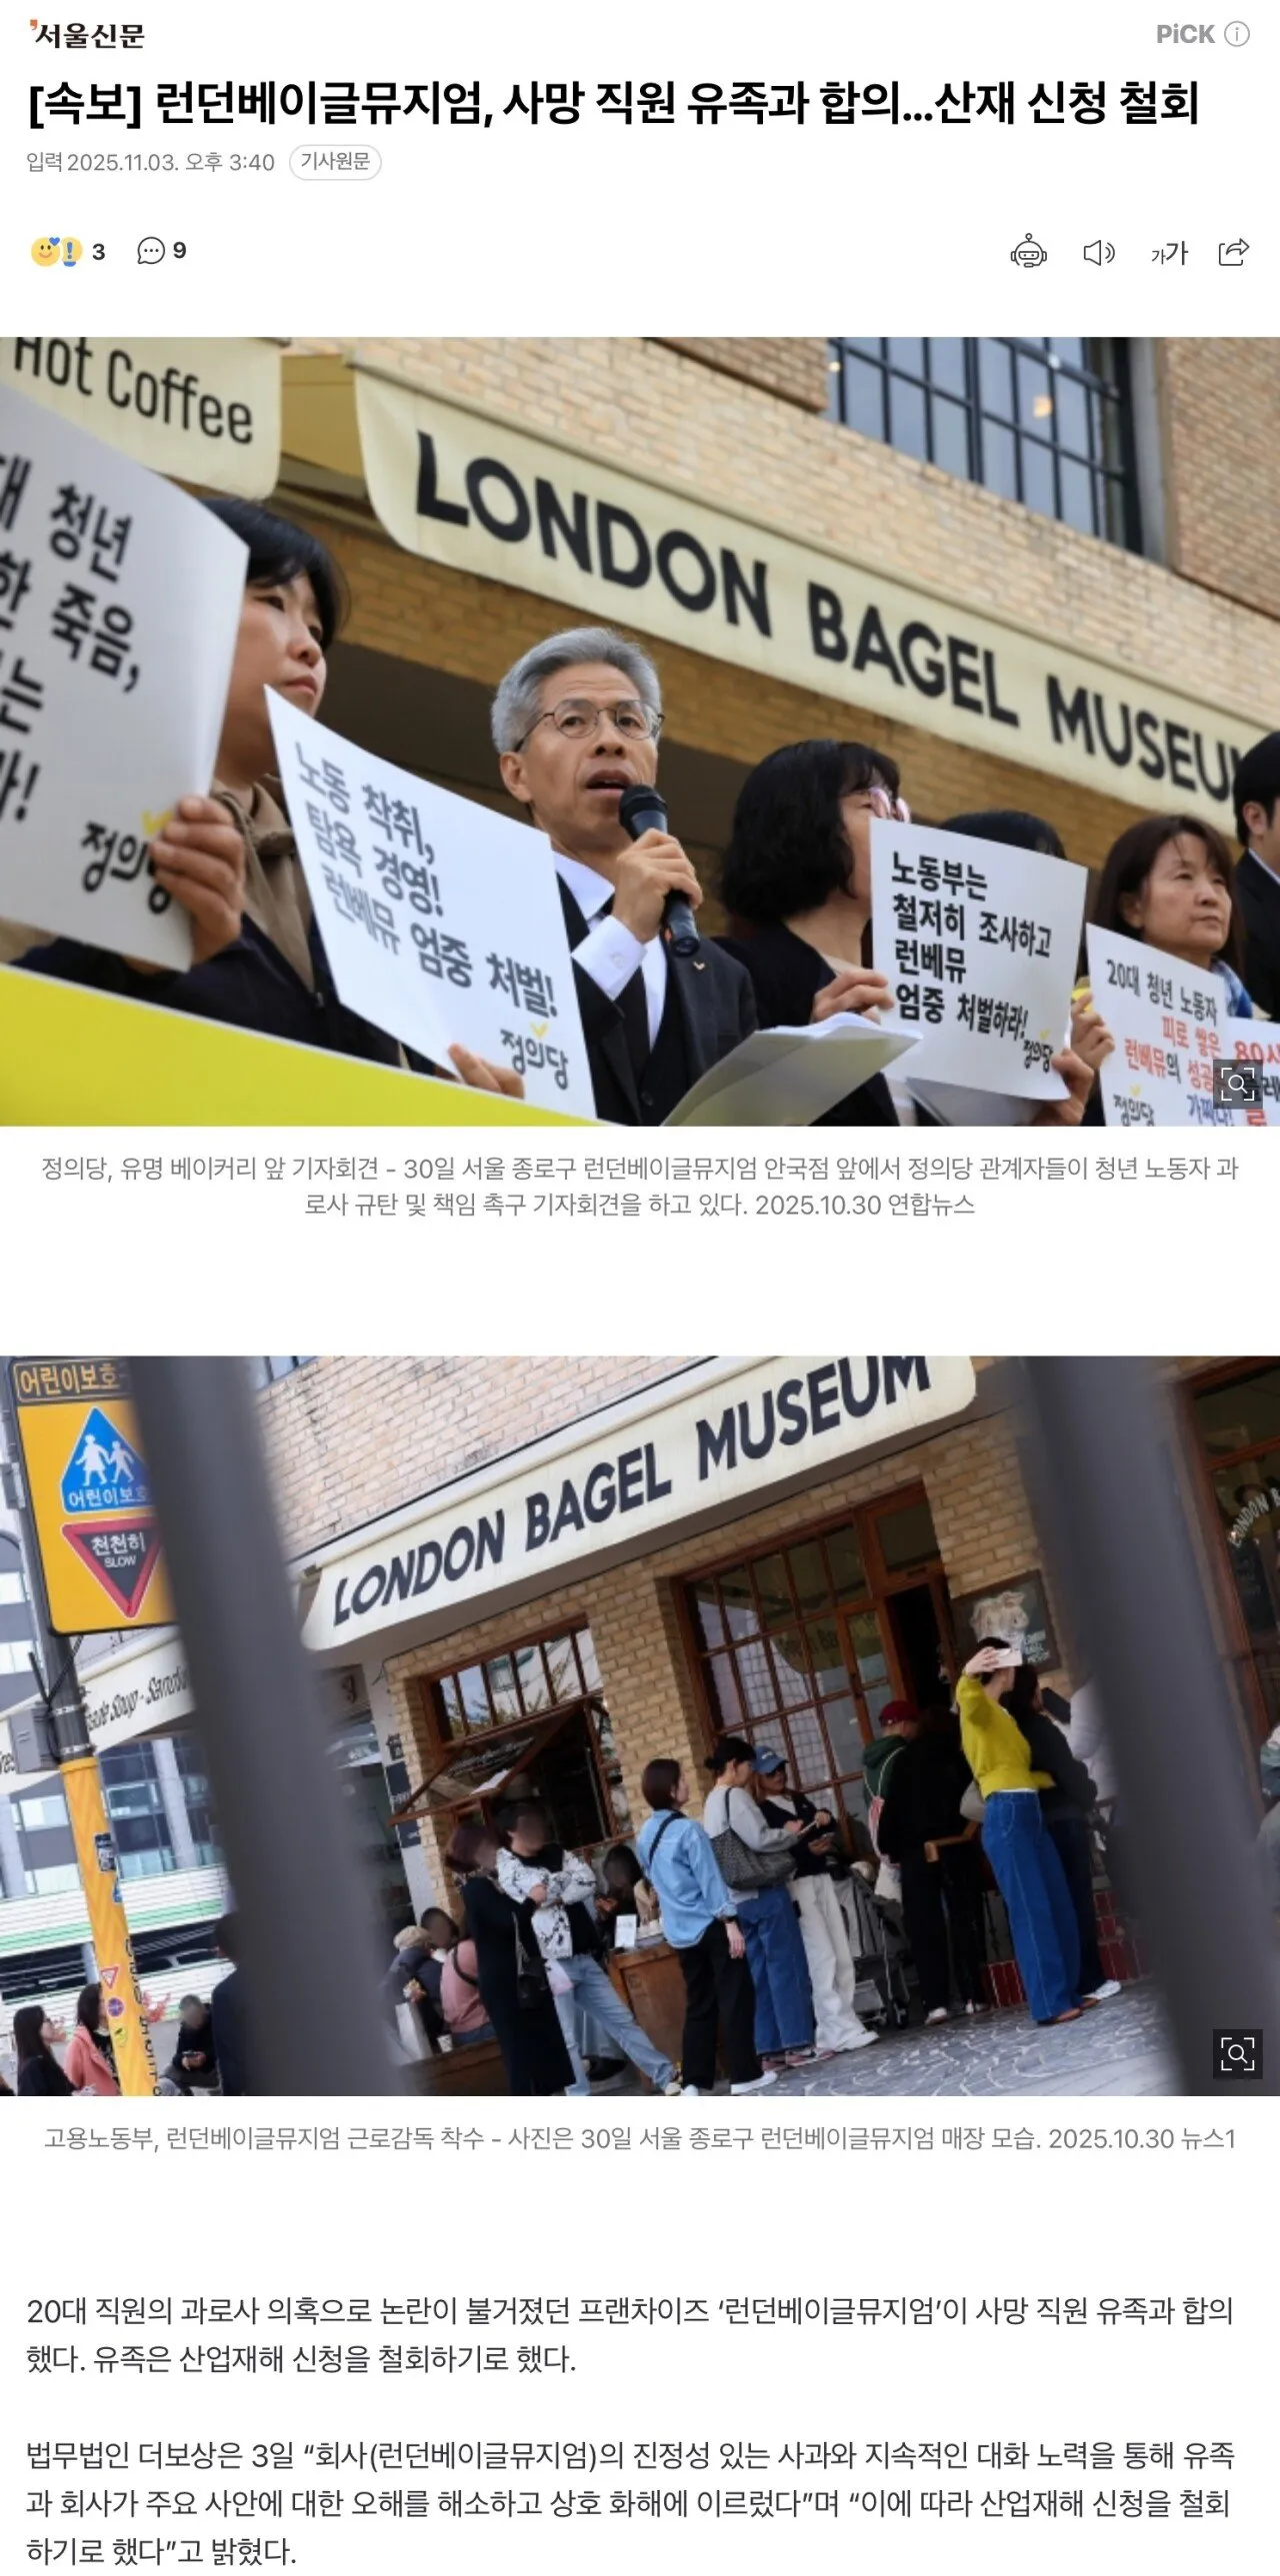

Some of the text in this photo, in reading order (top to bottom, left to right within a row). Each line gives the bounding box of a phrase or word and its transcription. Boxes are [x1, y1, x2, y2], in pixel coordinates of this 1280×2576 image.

[14, 337, 253, 445] Hot Coffee
[50, 483, 133, 585] 청년
[52, 582, 141, 695] 죽음,
[417, 430, 1243, 803] LONDON BAGEL MUSEU
[295, 741, 435, 865] 노동 착취,
[305, 800, 444, 918] 탐욕 경영!
[891, 851, 988, 903] 노동부는
[320, 862, 559, 1019] 런베뮤 엄중 처벌!
[892, 893, 1053, 959] 철저히 조사하고
[894, 939, 967, 985] 런베뮤
[1106, 958, 1218, 1028] 20대 청년 노동자
[895, 983, 1029, 1042] 엄중 처벌하라!
[1161, 1015, 1190, 1050] 피로
[500, 1029, 569, 1092] 정의당
[1022, 1039, 1054, 1075] 정의당
[1124, 1038, 1182, 1085] 런베뮤의
[1113, 1095, 1155, 1127] 정의당
[20, 1362, 127, 1396] 어린이보호
[334, 1356, 932, 1627] LONDON BAGEL MUSEUM
[91, 1530, 146, 1556] 천천히
[104, 1555, 137, 1568] SLOW
